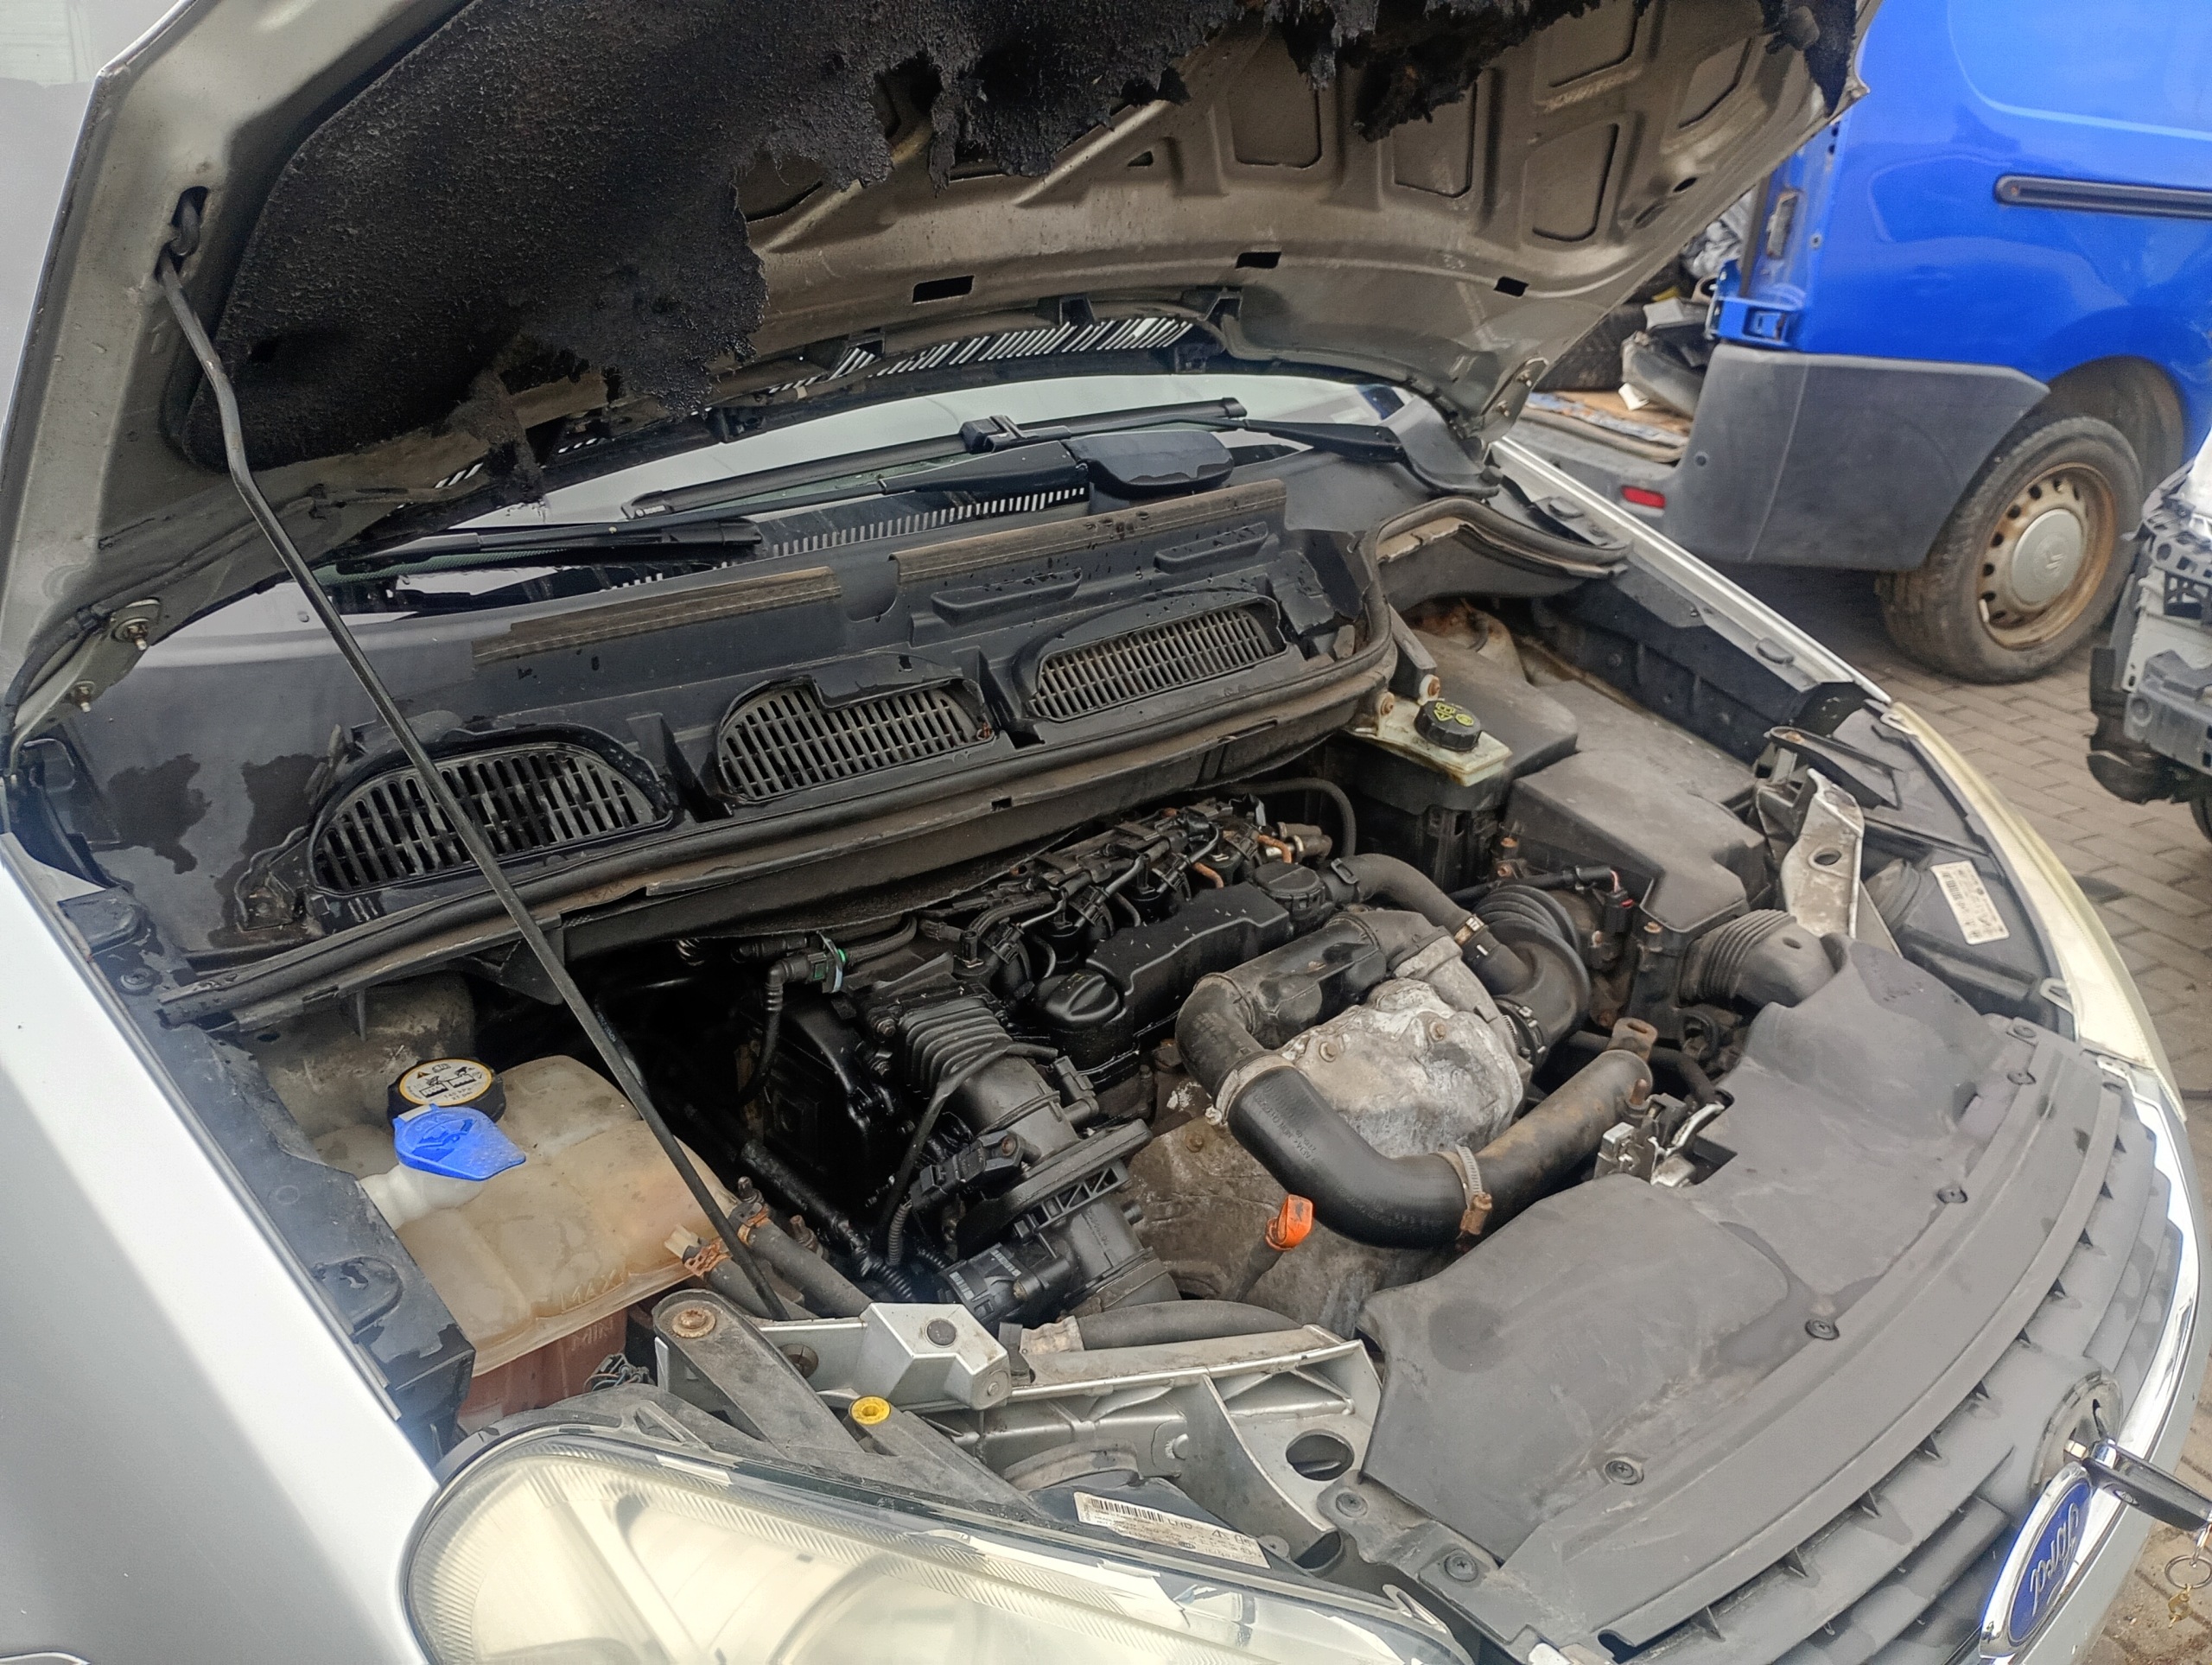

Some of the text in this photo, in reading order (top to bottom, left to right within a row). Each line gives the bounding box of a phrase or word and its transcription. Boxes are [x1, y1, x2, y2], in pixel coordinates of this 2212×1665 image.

[560, 1268, 616, 1313] MAX
[571, 1315, 613, 1351] MIN
[2029, 1503, 2079, 1617] Ford
